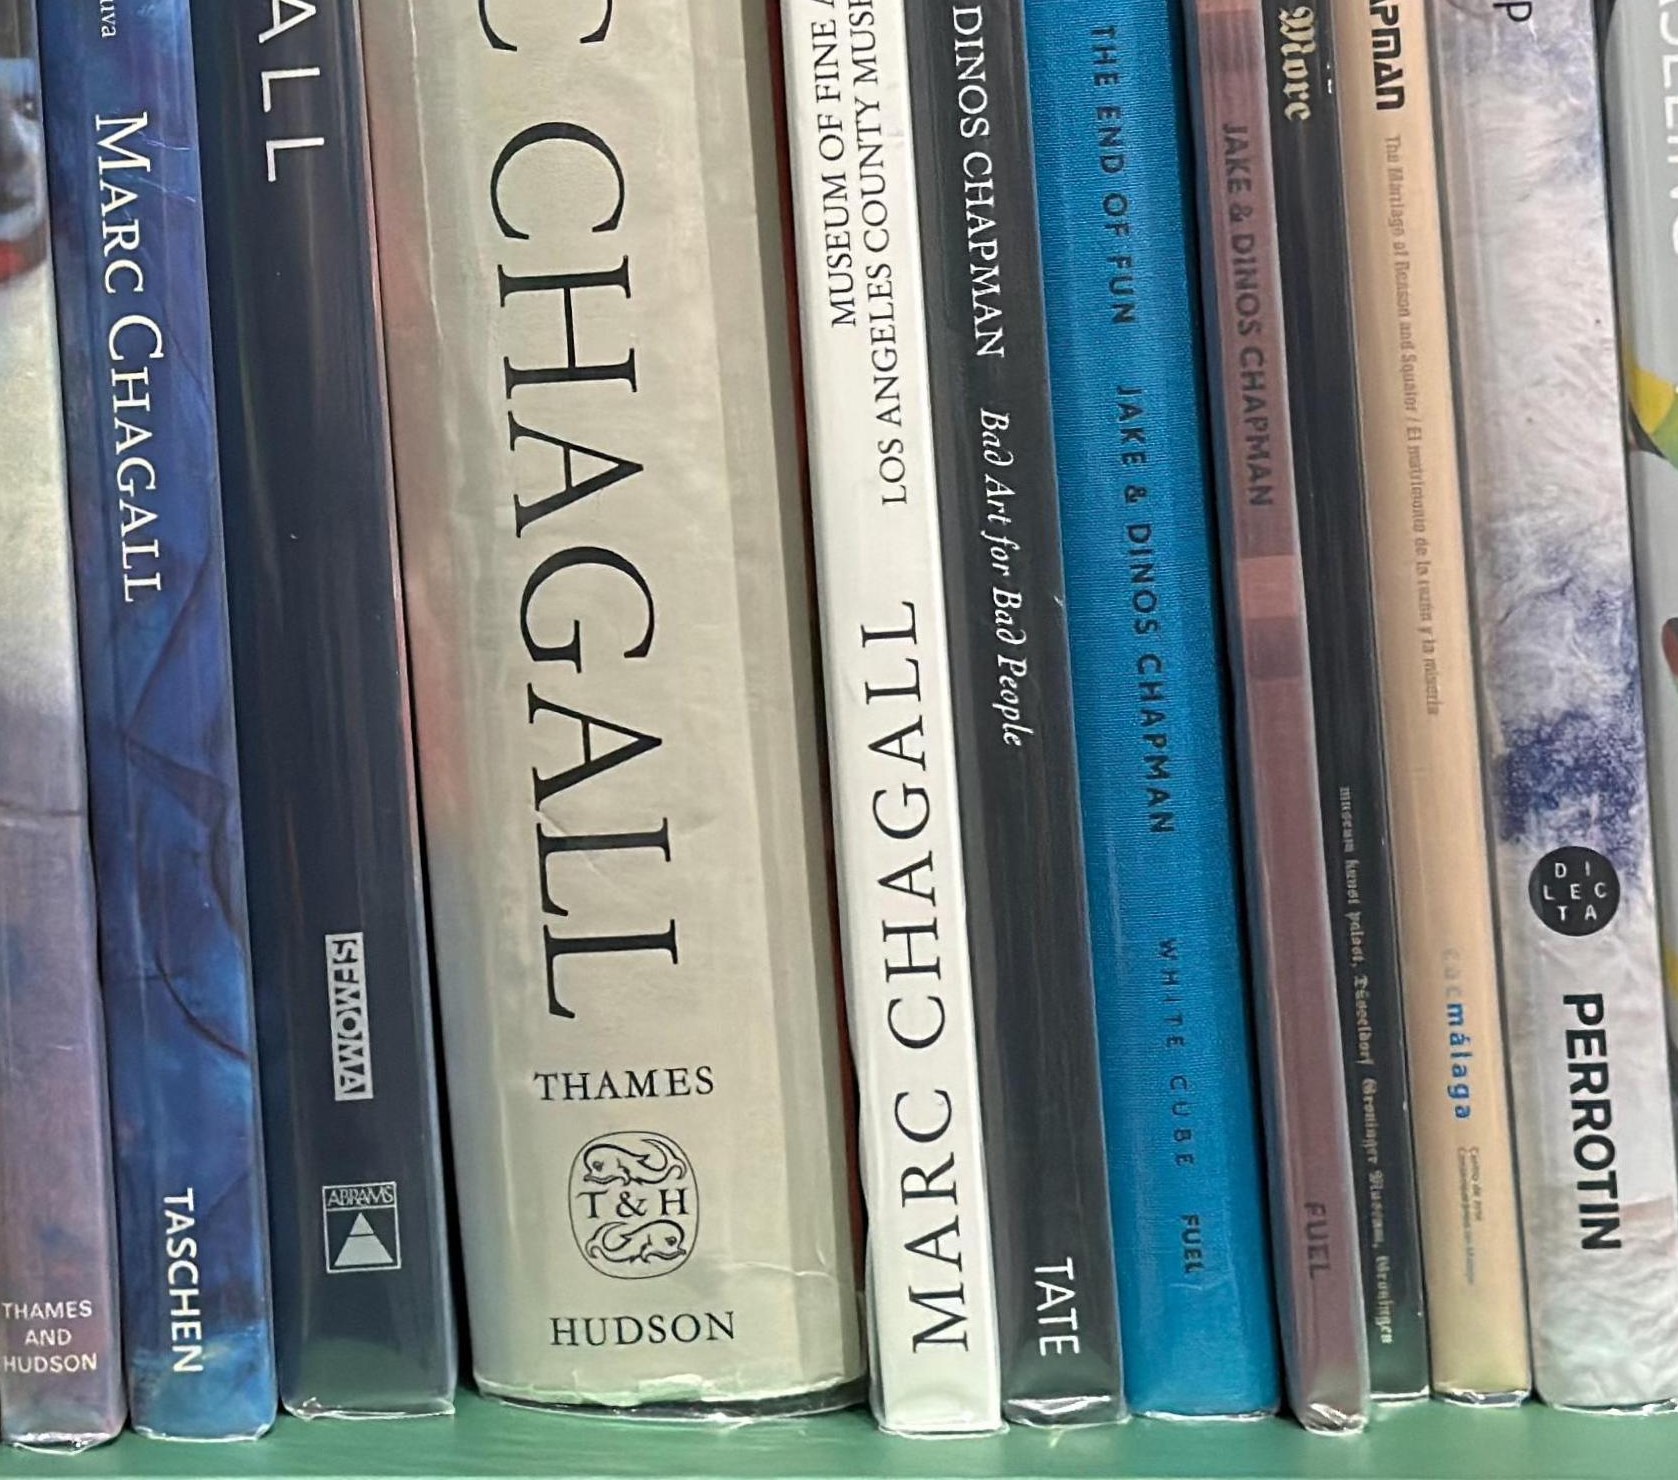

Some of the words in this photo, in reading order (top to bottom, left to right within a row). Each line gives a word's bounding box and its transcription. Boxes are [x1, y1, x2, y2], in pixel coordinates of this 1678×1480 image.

[811, 19, 842, 103] FINE
[951, 5, 989, 140] DINOS
[1090, 24, 1121, 90] THE
[1277, 5, 1318, 122] More
[817, 113, 844, 163] OF
[852, 97, 890, 255] COUNTY
[1096, 104, 1126, 176] END
[1222, 121, 1253, 193] JAKE
[1383, 134, 1402, 165] The
[821, 173, 856, 330] MUSEUM
[961, 151, 1005, 361] CHAPMAN
[1101, 191, 1132, 239] OF
[1107, 255, 1137, 325] FUN
[1230, 231, 1262, 337] DINOS
[865, 261, 901, 429] ANGELES
[979, 406, 1015, 469] Bad
[1114, 383, 1147, 468] JAKE
[1237, 345, 1274, 507] CHAPMAN
[877, 437, 907, 507] LOS
[984, 473, 1017, 526] Art
[489, 120, 678, 1020] CHAGALL
[979, 529, 1020, 579] for
[1125, 522, 1164, 637] DINOS
[990, 585, 1028, 646] Bad
[991, 653, 1035, 749] People
[1135, 651, 1176, 835] CHAPMAN
[859, 599, 946, 1051] CHAGALL
[1158, 936, 1187, 1049] WHITE
[533, 1065, 715, 1102] THAMES
[1446, 1001, 1473, 1120] málaga
[1168, 1072, 1195, 1169] CUBE
[1562, 992, 1623, 1251] PERROTIN
[893, 1088, 970, 1353] MARC
[1180, 1213, 1206, 1275] FUEL
[1303, 1199, 1332, 1281] FUEL
[3, 1299, 93, 1321] THAMES
[162, 1187, 203, 1373] TASCHEN
[1034, 1255, 1081, 1357] TATE
[3, 1352, 98, 1374] HUDSON
[24, 1327, 72, 1347] AND
[549, 1310, 737, 1347] HUDSON
